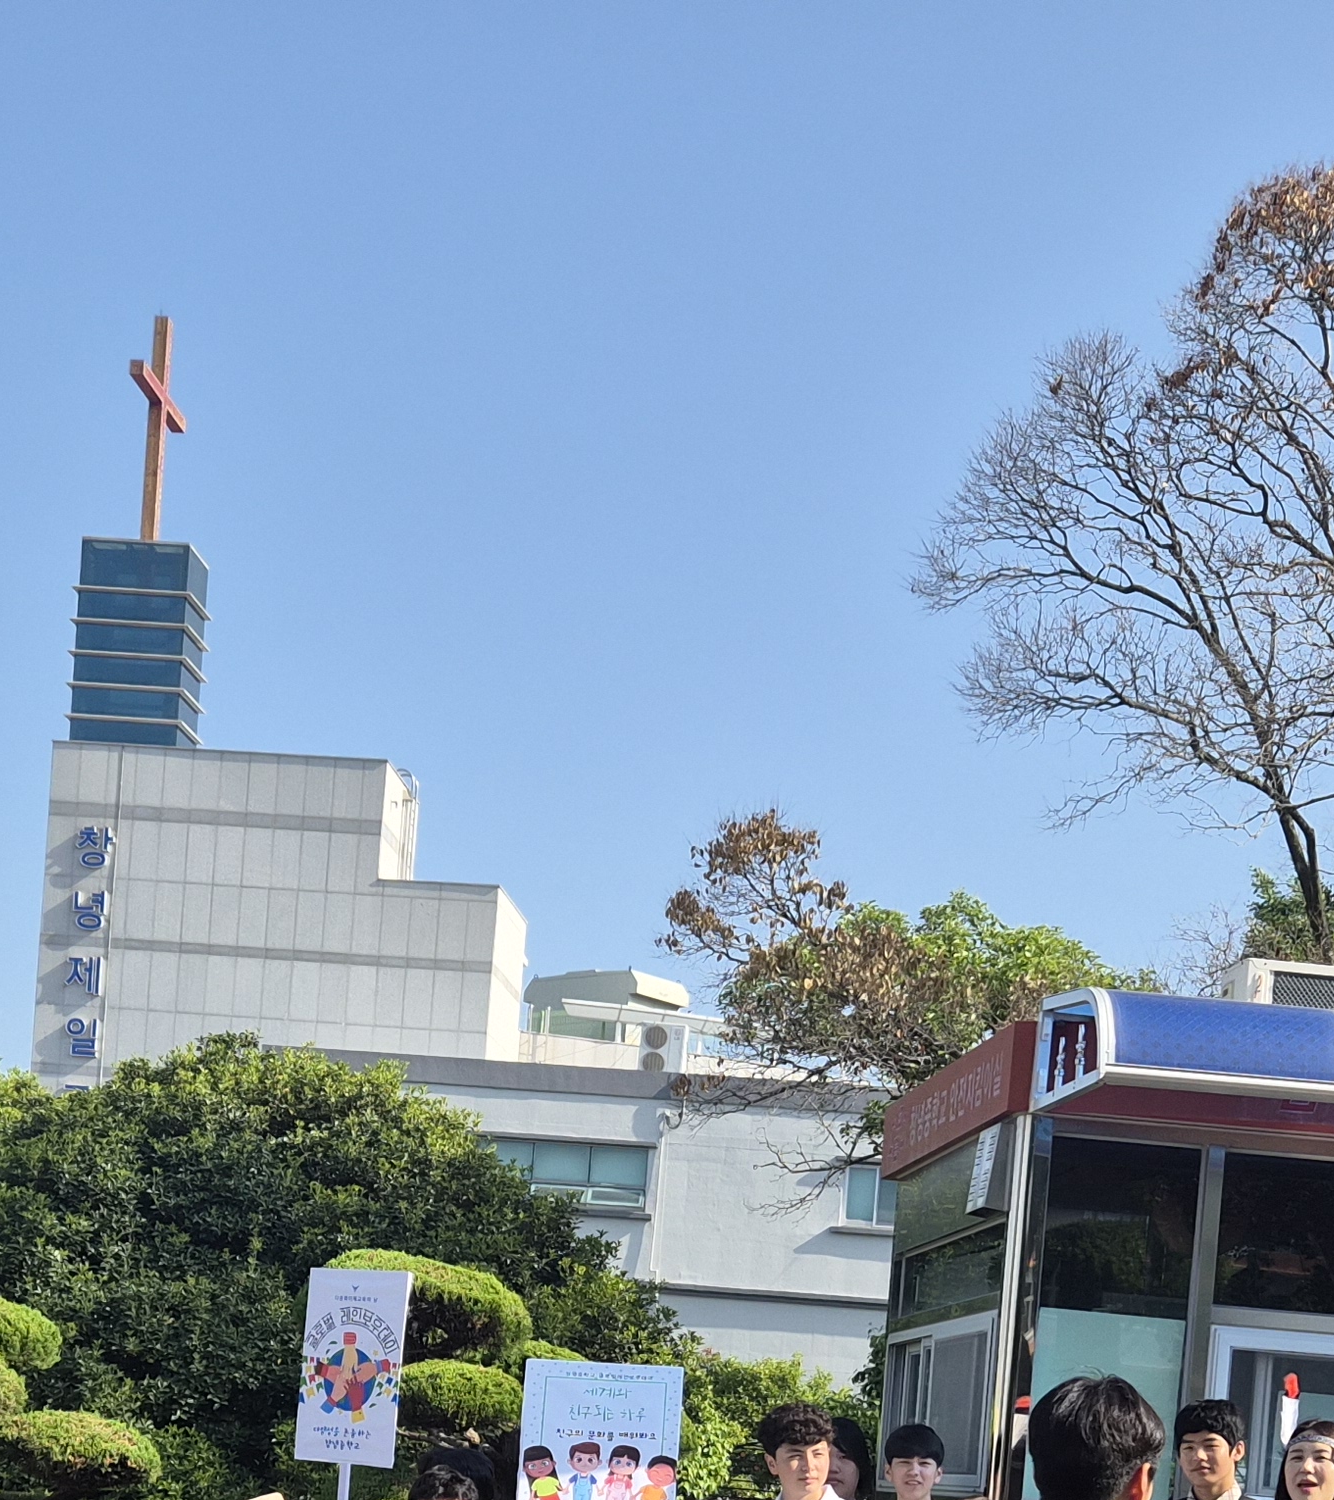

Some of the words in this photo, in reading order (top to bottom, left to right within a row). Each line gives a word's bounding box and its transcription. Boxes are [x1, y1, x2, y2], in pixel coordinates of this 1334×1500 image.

[65, 826, 114, 1093] 창녕제일
[306, 1313, 336, 1350] 글로벌
[583, 1387, 632, 1399] 세계와
[569, 1404, 614, 1422] 친구되는
[620, 1408, 646, 1422] 하루
[556, 1428, 584, 1438] 친구의
[588, 1430, 614, 1441] 문화를
